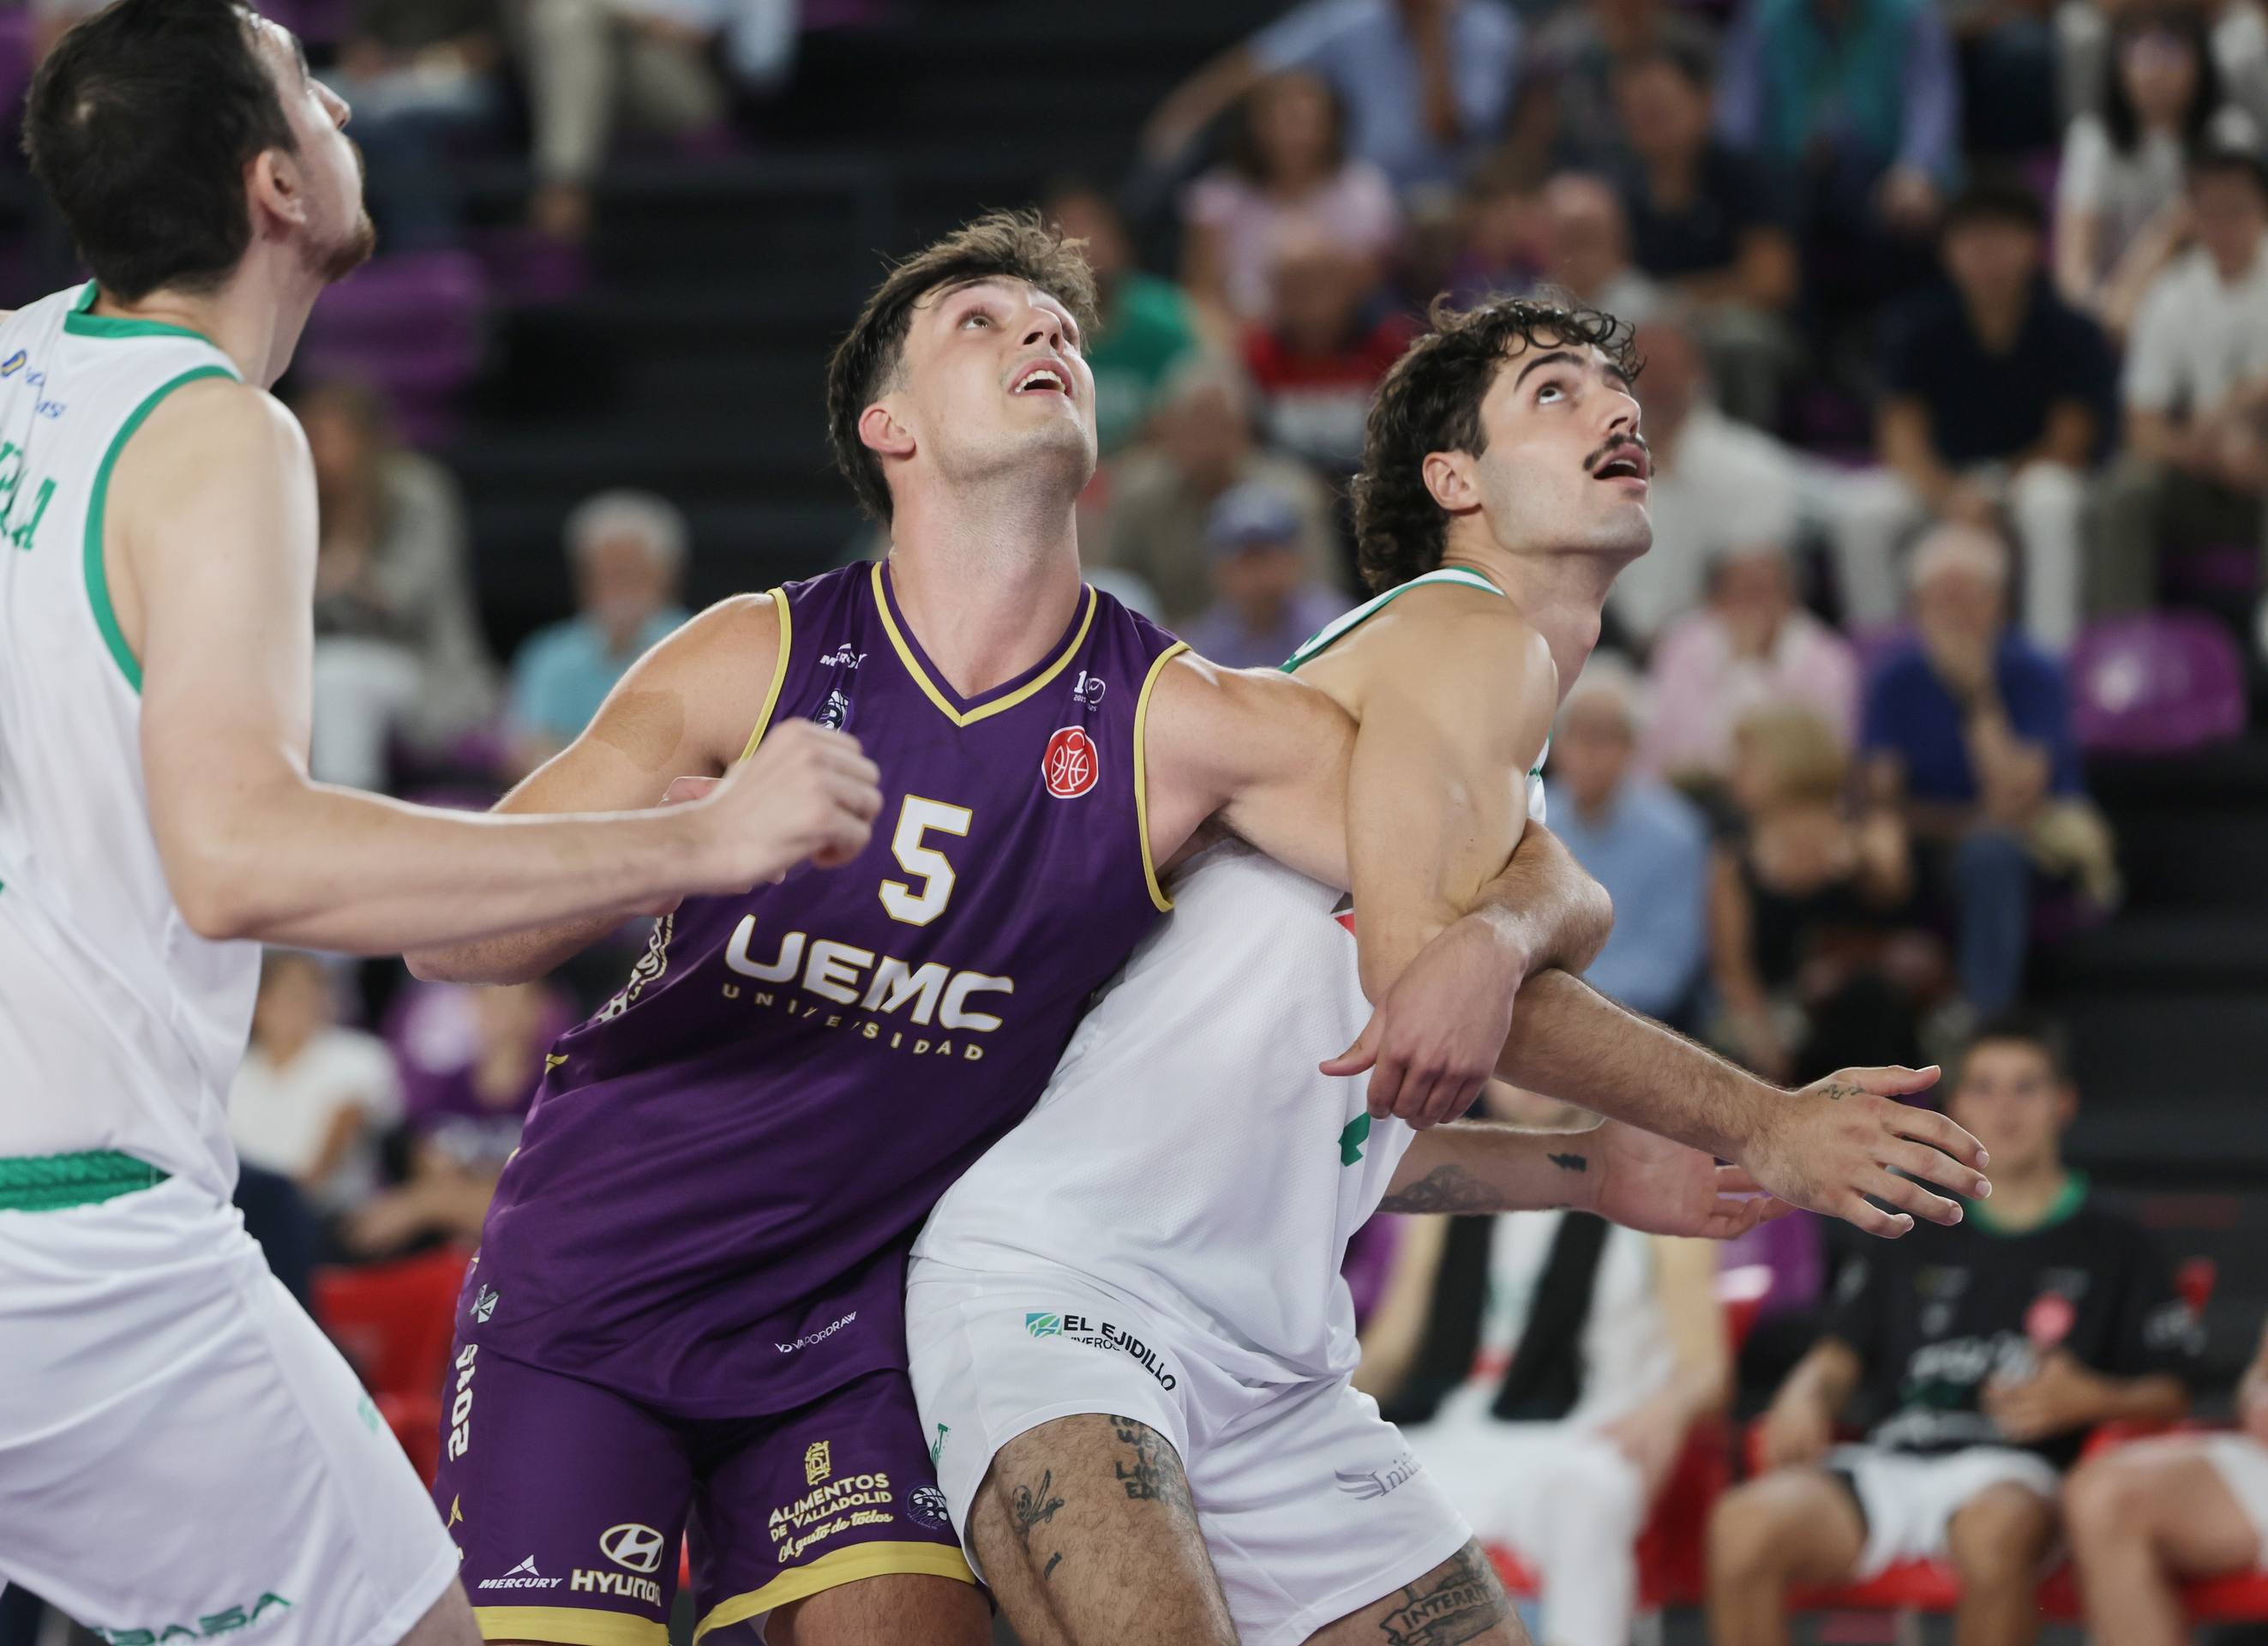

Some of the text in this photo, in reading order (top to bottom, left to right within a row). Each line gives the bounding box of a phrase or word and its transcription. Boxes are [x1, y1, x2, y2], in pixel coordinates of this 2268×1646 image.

[879, 794, 973, 927] 5
[724, 913, 1015, 1032] UEMC
[721, 982, 984, 1060] UNIVESIDAD
[791, 1311, 857, 1349] VAPORDRAW
[1063, 1314, 1177, 1391] EL EJIDILLO
[768, 1472, 891, 1529] ALIMENTOS
[770, 1523, 788, 1543] DE
[792, 1491, 893, 1529] VALLADOLID
[795, 1522, 832, 1558] gusto
[831, 1517, 851, 1535] de
[850, 1509, 894, 1527] todos
[477, 1577, 563, 1589] MERCURY
